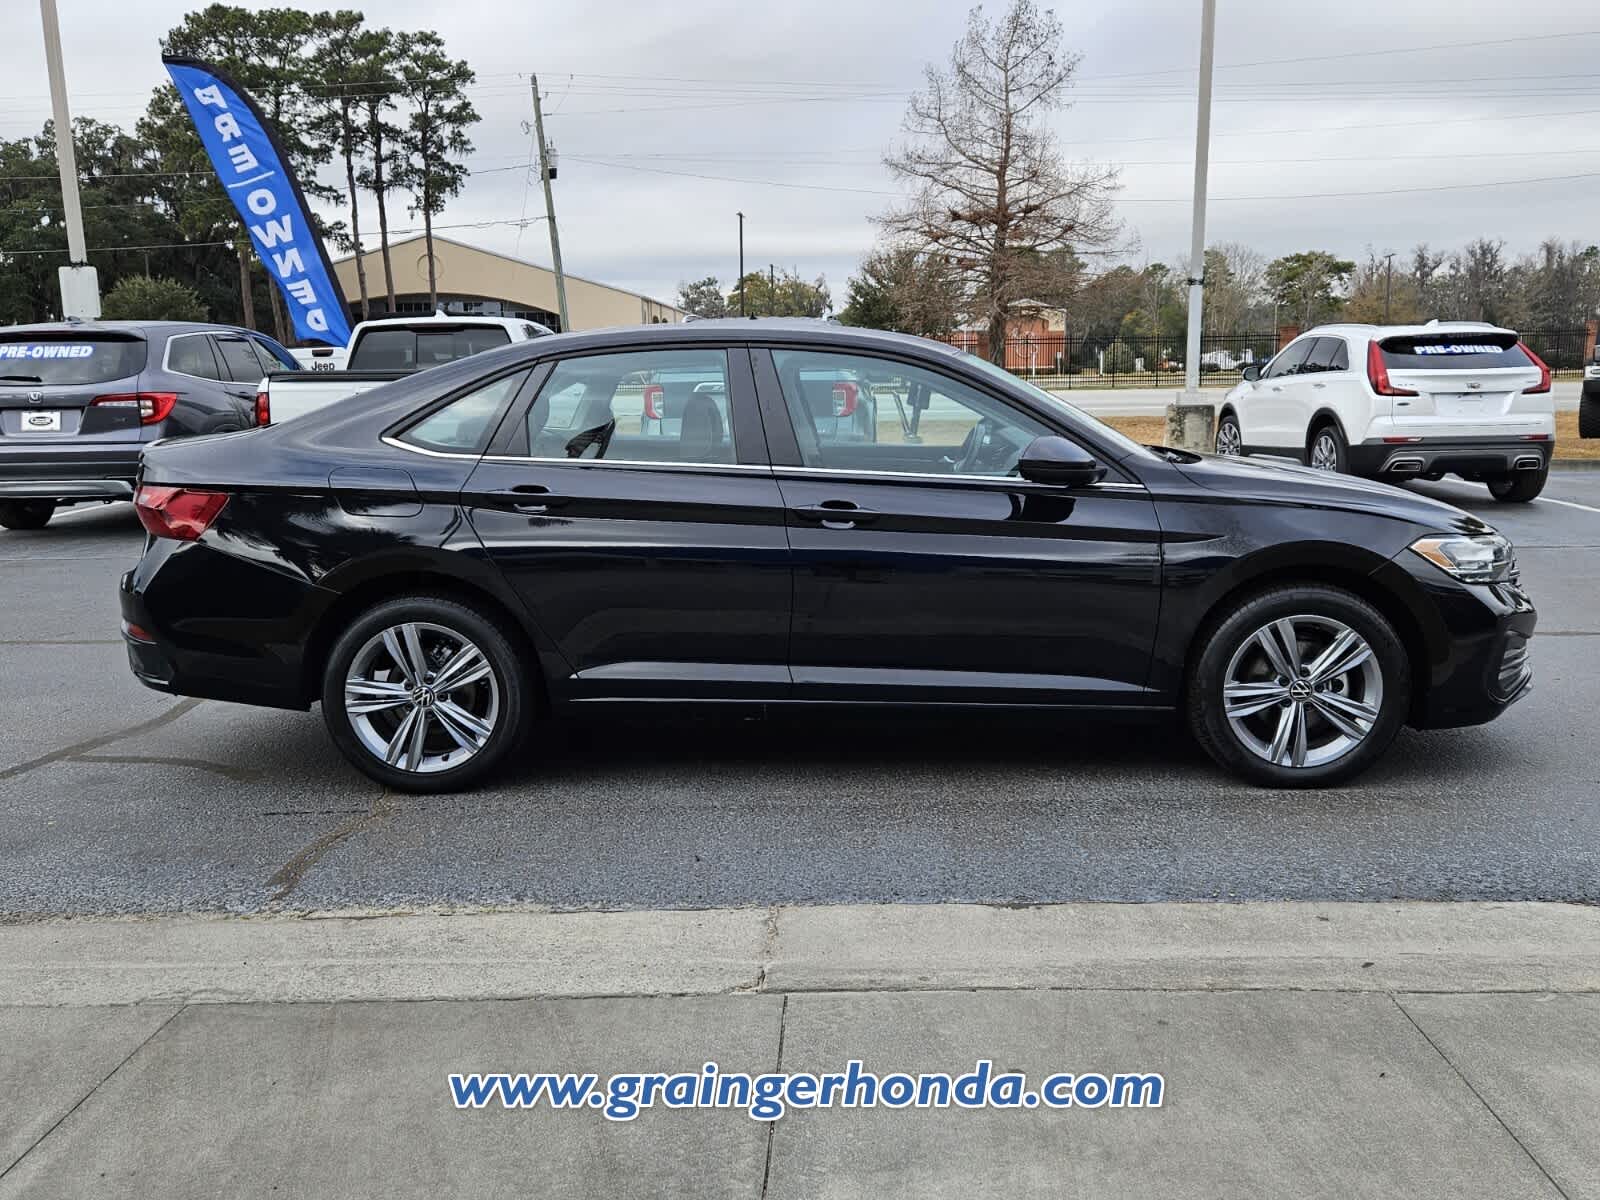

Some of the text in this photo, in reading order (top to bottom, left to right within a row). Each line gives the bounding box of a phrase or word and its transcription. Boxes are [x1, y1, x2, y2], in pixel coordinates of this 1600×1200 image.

[0, 345, 94, 358] PRE-OWNED
[1413, 344, 1504, 355] PRE-OWNED
[311, 360, 335, 371] Jeep
